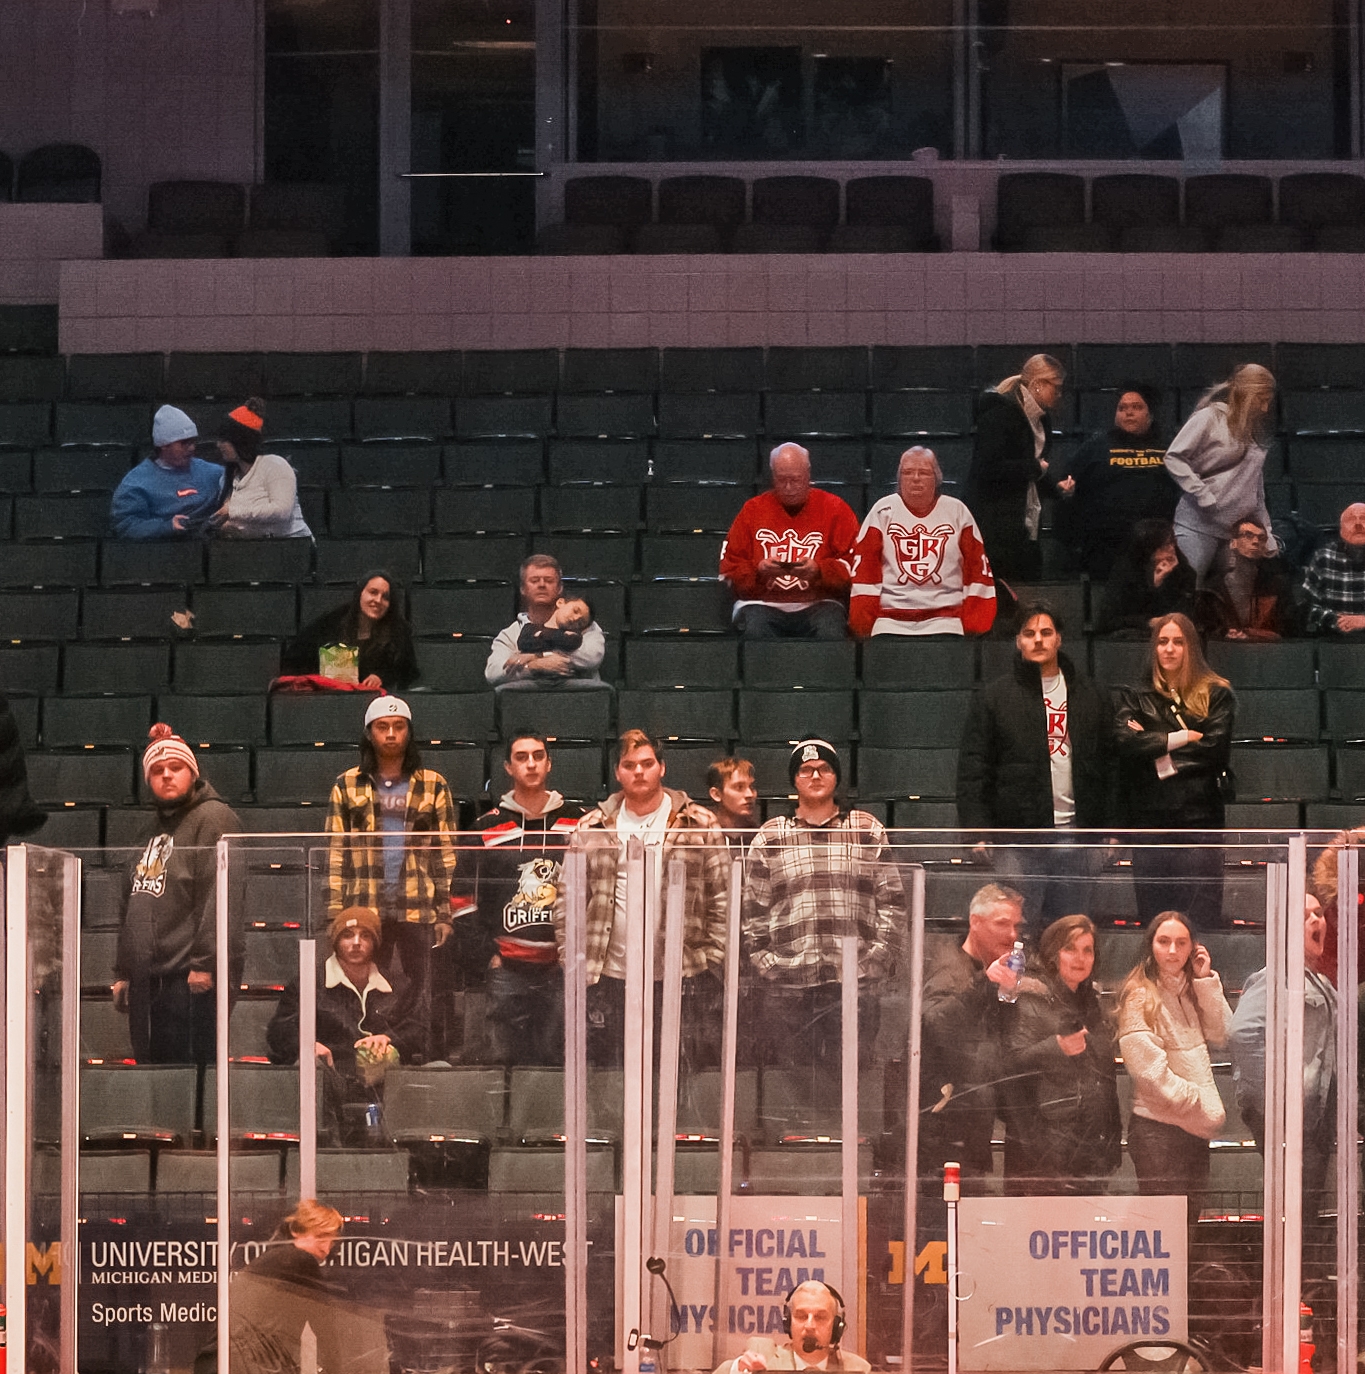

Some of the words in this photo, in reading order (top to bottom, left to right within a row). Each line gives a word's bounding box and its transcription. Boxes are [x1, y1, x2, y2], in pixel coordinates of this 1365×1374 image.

[1109, 456, 1166, 466] FOOTBAL
[505, 902, 554, 929] GRIFFI
[416, 1240, 594, 1268] HEALTH-WE
[1028, 1229, 1171, 1260] OFFICIAL
[91, 1270, 173, 1285] MICHIGAN
[1079, 1267, 1170, 1298] TEAM
[91, 1302, 153, 1327] Sports
[160, 1302, 218, 1324] Medic
[995, 1305, 1171, 1336] PHYSICIANS
